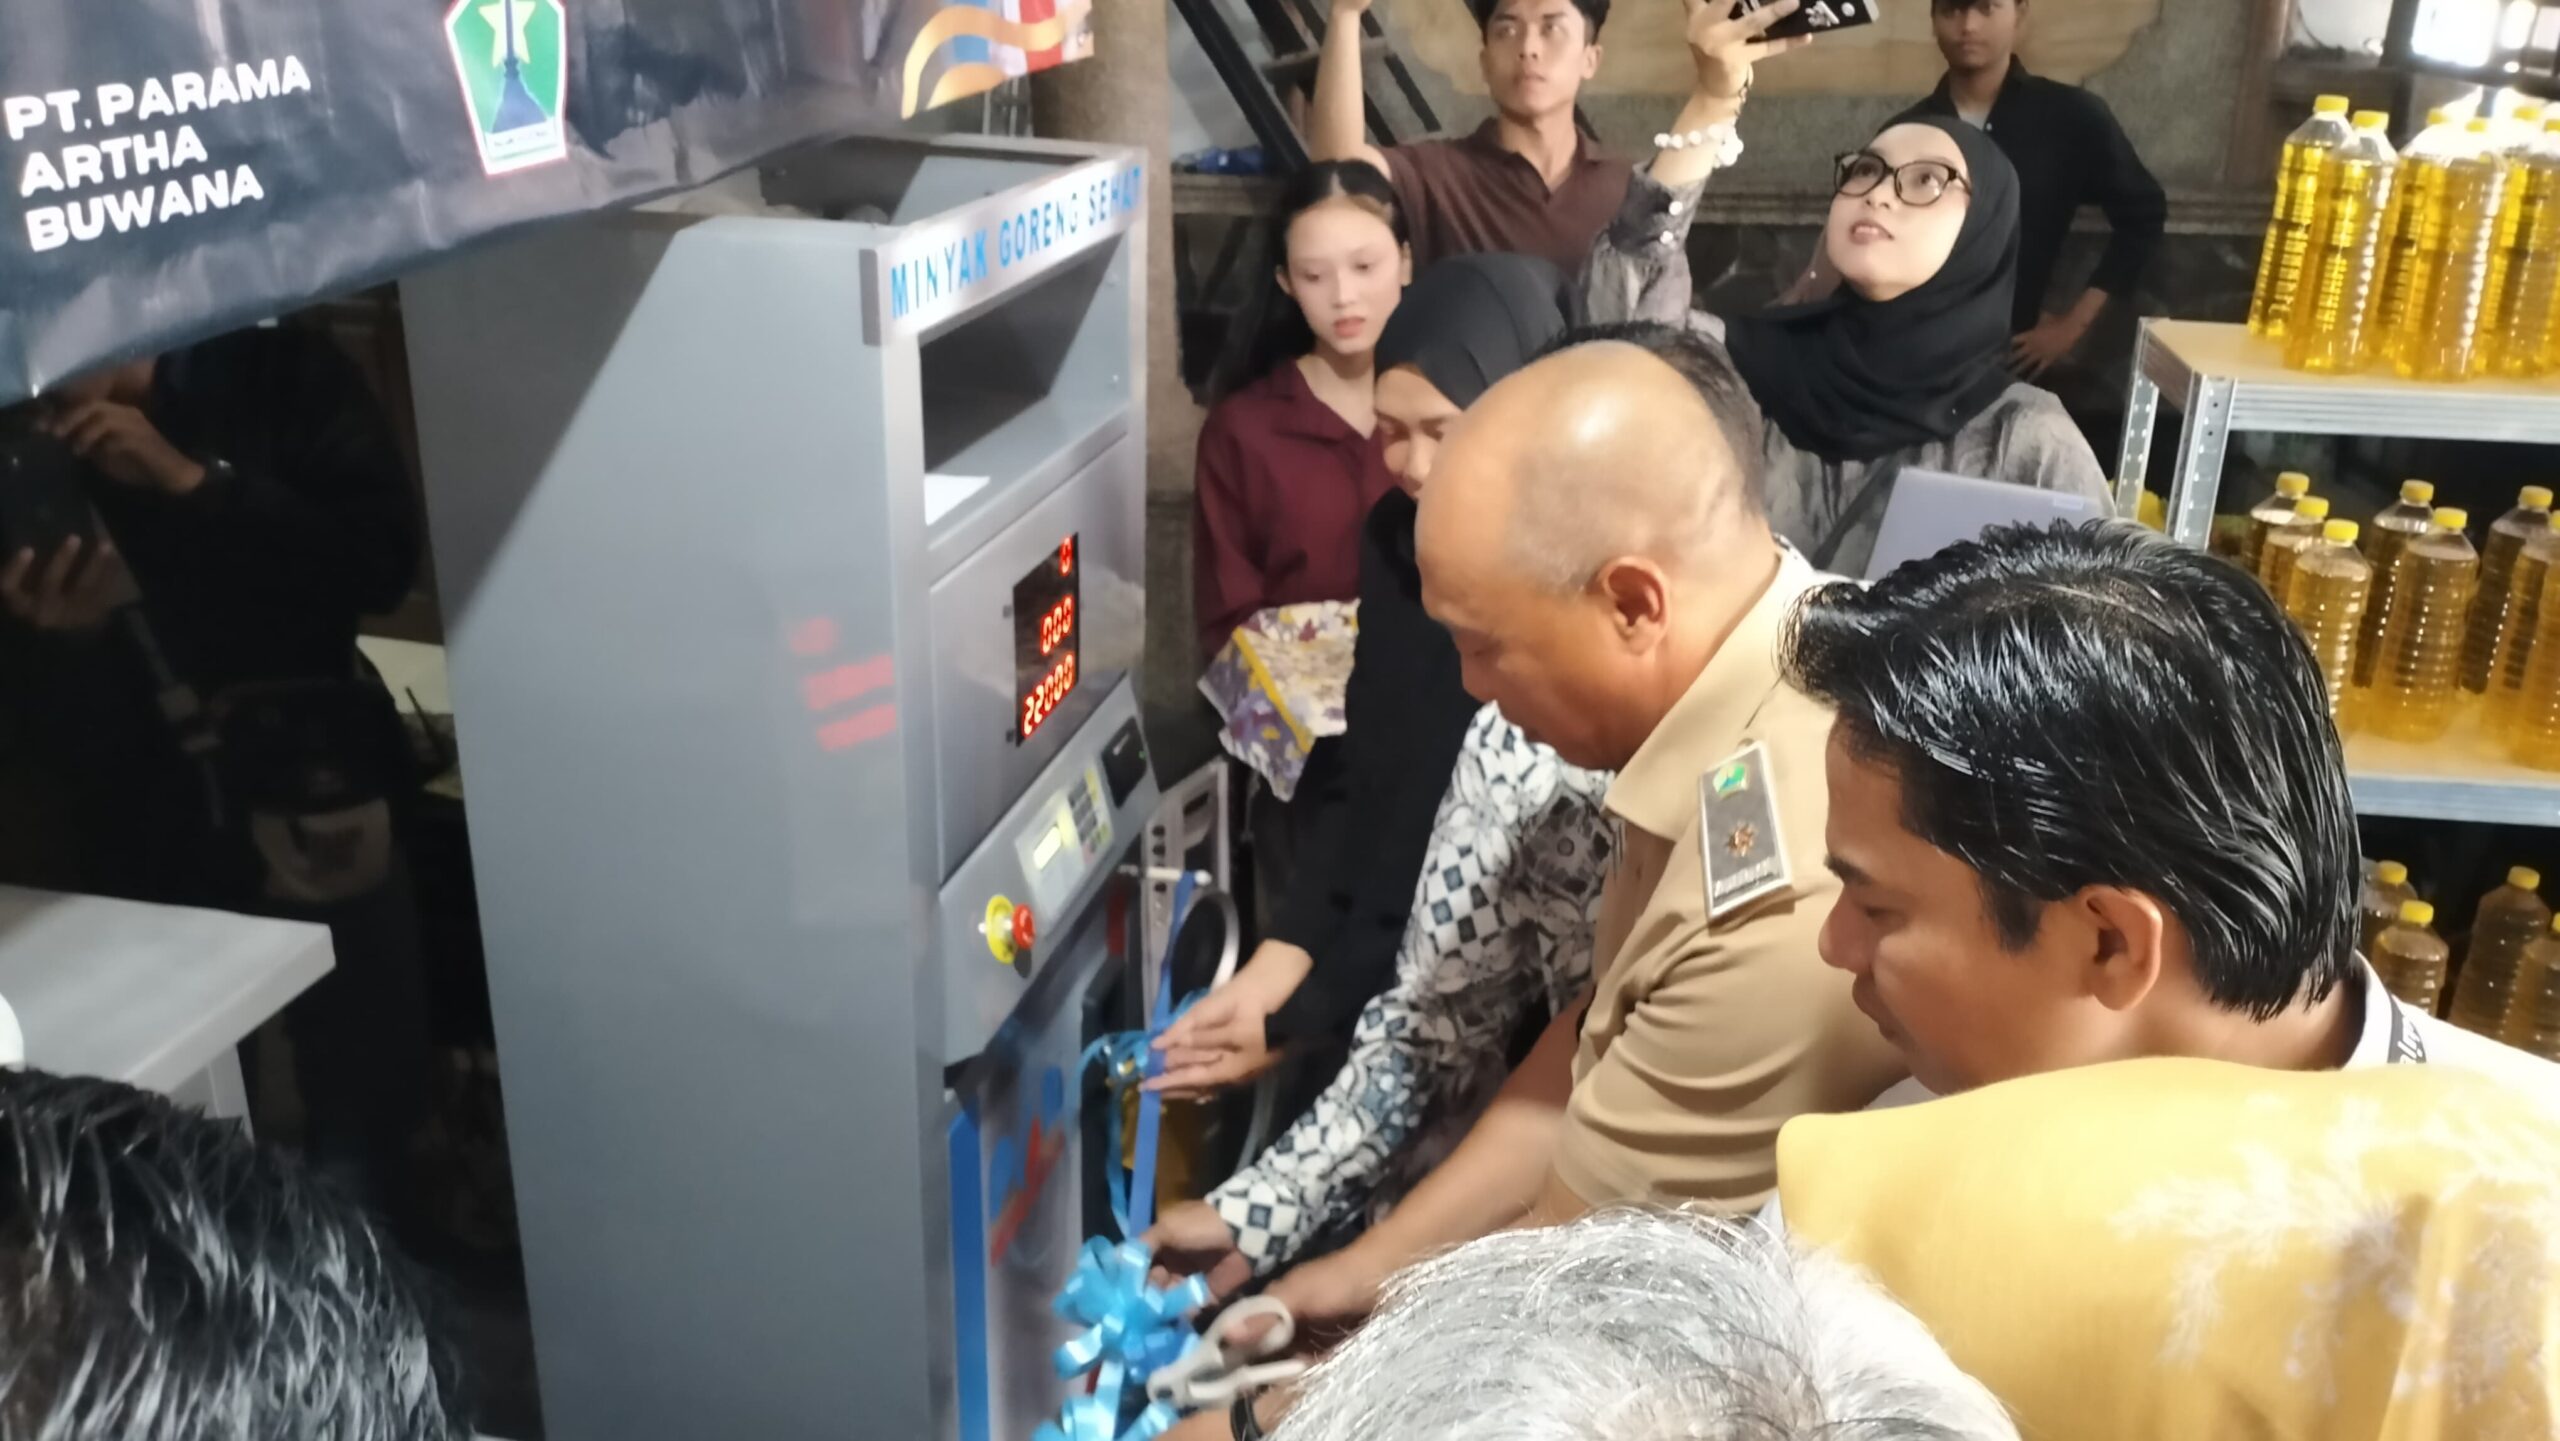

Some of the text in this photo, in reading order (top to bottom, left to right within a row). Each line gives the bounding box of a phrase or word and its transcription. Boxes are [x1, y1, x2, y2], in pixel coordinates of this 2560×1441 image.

[21, 125, 207, 197] ARTHA
[26, 164, 264, 252] BUWANA
[891, 227, 989, 319] MINYAK
[998, 192, 1079, 268] GORENG
[1041, 596, 1073, 655] 000
[1022, 653, 1074, 737] 22000
